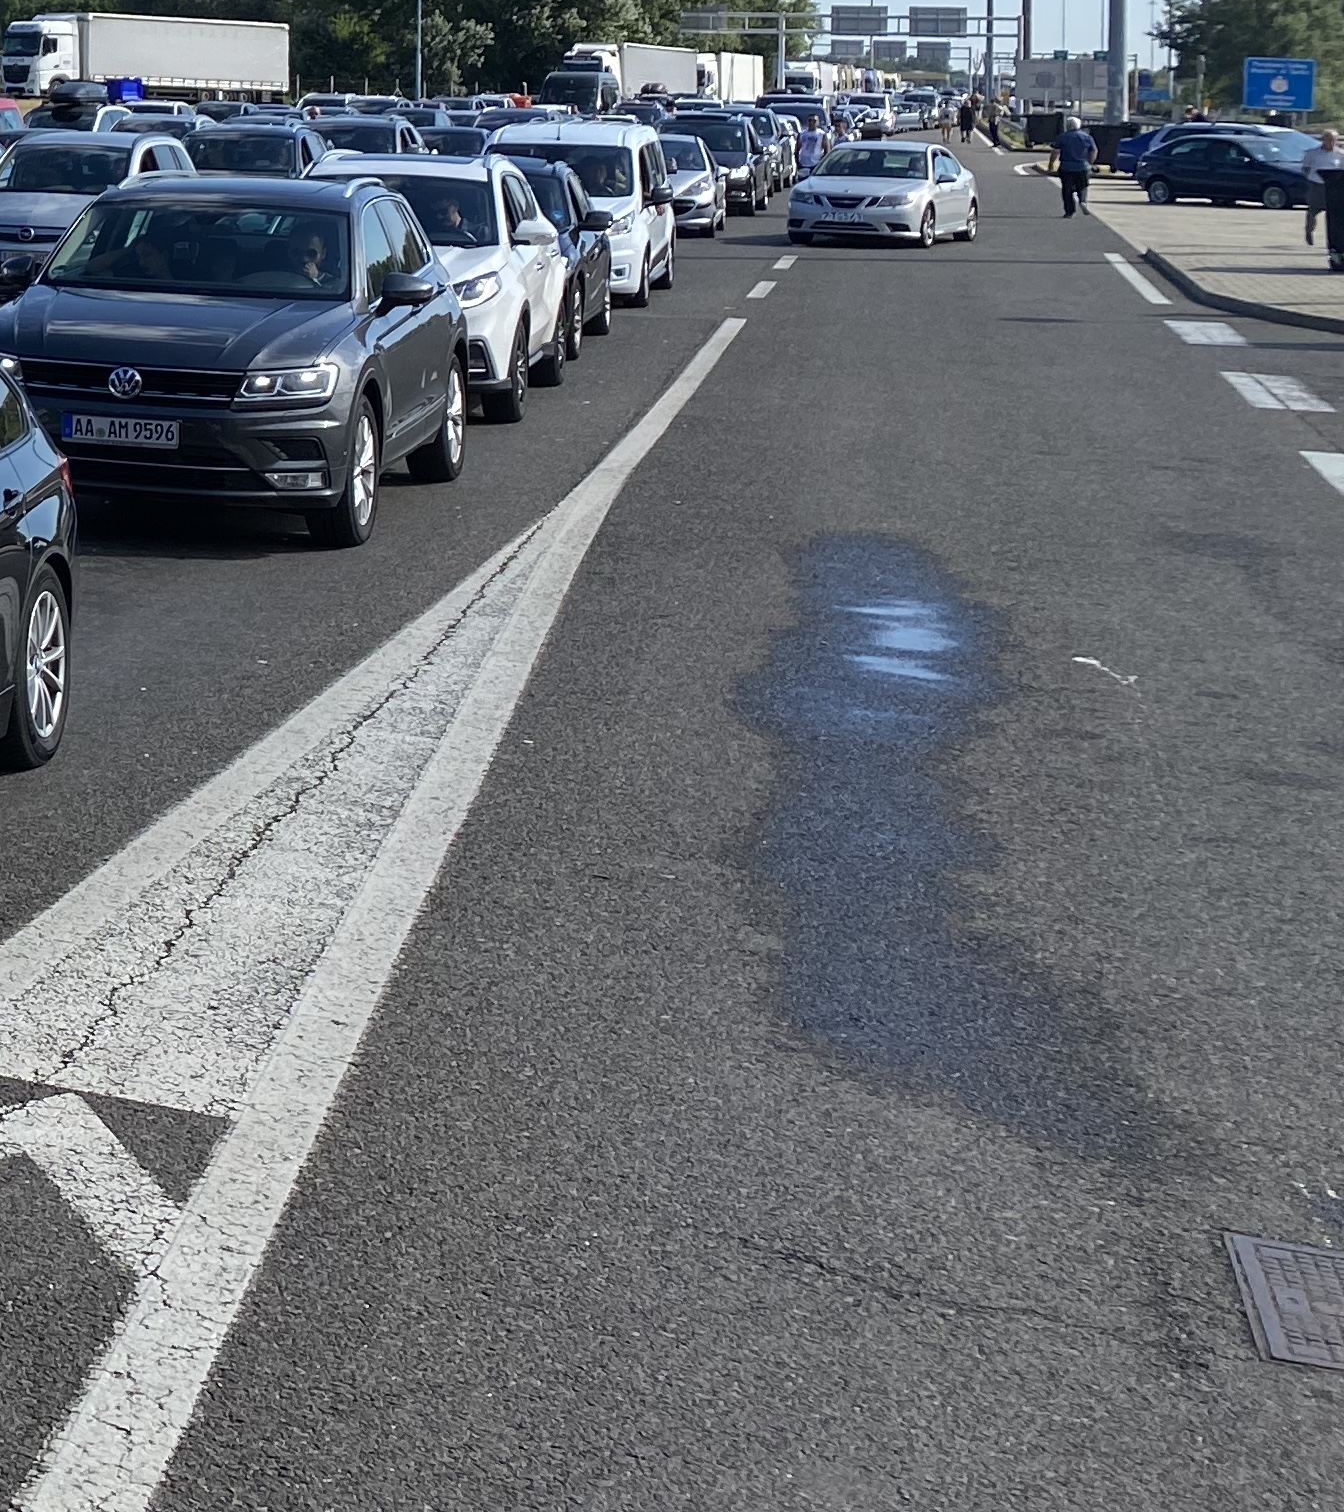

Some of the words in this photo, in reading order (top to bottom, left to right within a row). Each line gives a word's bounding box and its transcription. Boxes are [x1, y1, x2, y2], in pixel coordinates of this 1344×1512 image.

[74, 417, 94, 438] AA
[108, 419, 129, 439] AM
[133, 421, 175, 442] 9596
